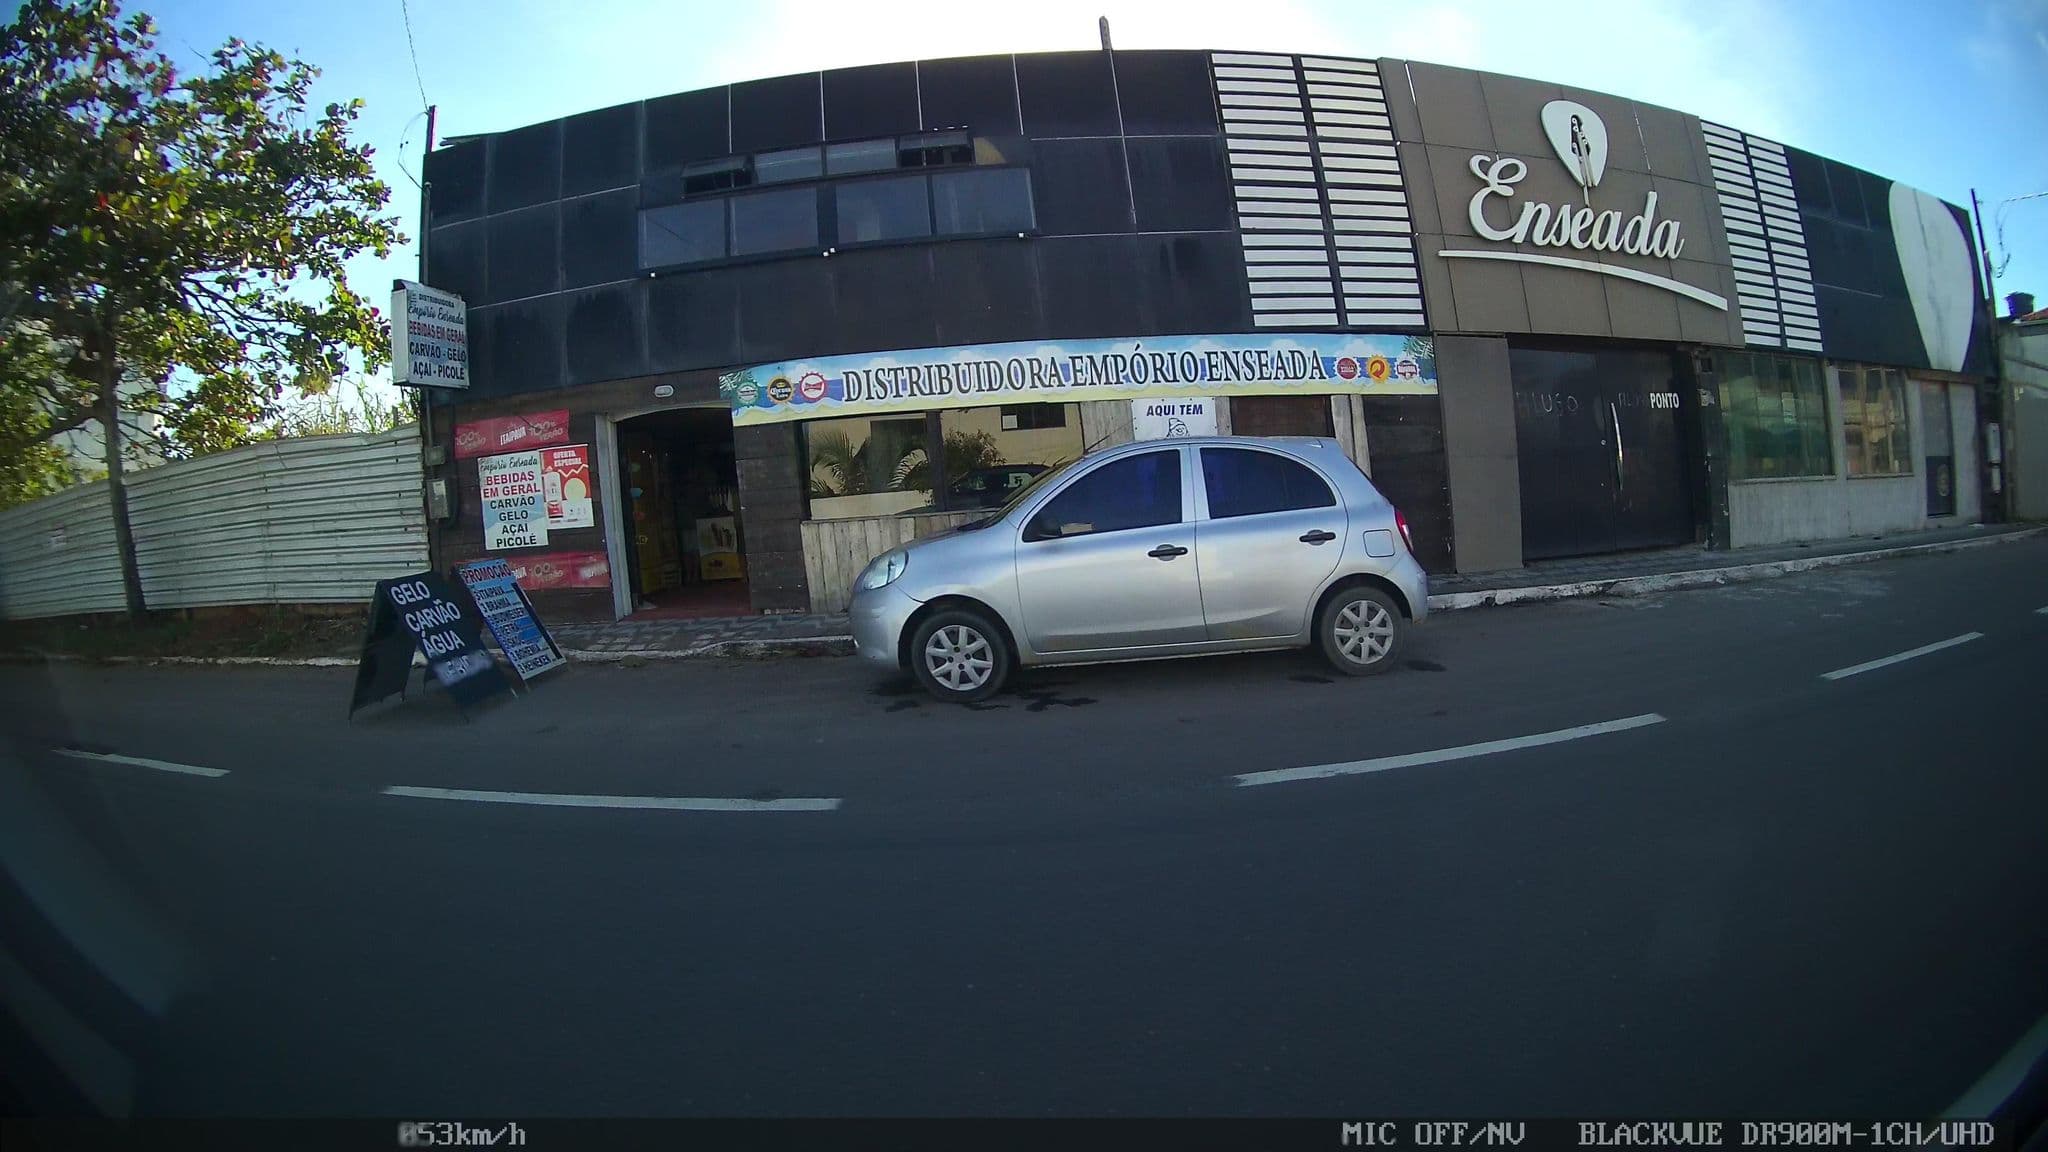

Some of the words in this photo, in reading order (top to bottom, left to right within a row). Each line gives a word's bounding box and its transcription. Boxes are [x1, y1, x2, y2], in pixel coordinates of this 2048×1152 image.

[1468, 153, 1686, 260] Enseada
[409, 321, 435, 338] BEBIDAS
[447, 327, 466, 344] GERAL
[410, 341, 441, 359] CARVÃO
[447, 348, 467, 362] GELO
[841, 356, 1066, 403] DISTRIBUIDORA
[1068, 343, 1199, 387] EMPÓRIO
[1205, 347, 1328, 384] ENSEADA
[1146, 404, 1176, 417] AQUI
[1179, 403, 1204, 416] TEM
[1649, 392, 1680, 409] PONTO
[486, 470, 535, 486] BEBIDAS
[483, 487, 499, 498] EM
[502, 483, 541, 496] GERAL
[489, 493, 536, 510] CARVÃO
[498, 509, 529, 522] GELO
[463, 562, 512, 584] PROMOÇÃO
[390, 580, 431, 606] GELO
[404, 599, 462, 634] CARVÃO
[422, 630, 466, 659] ÁGUA
